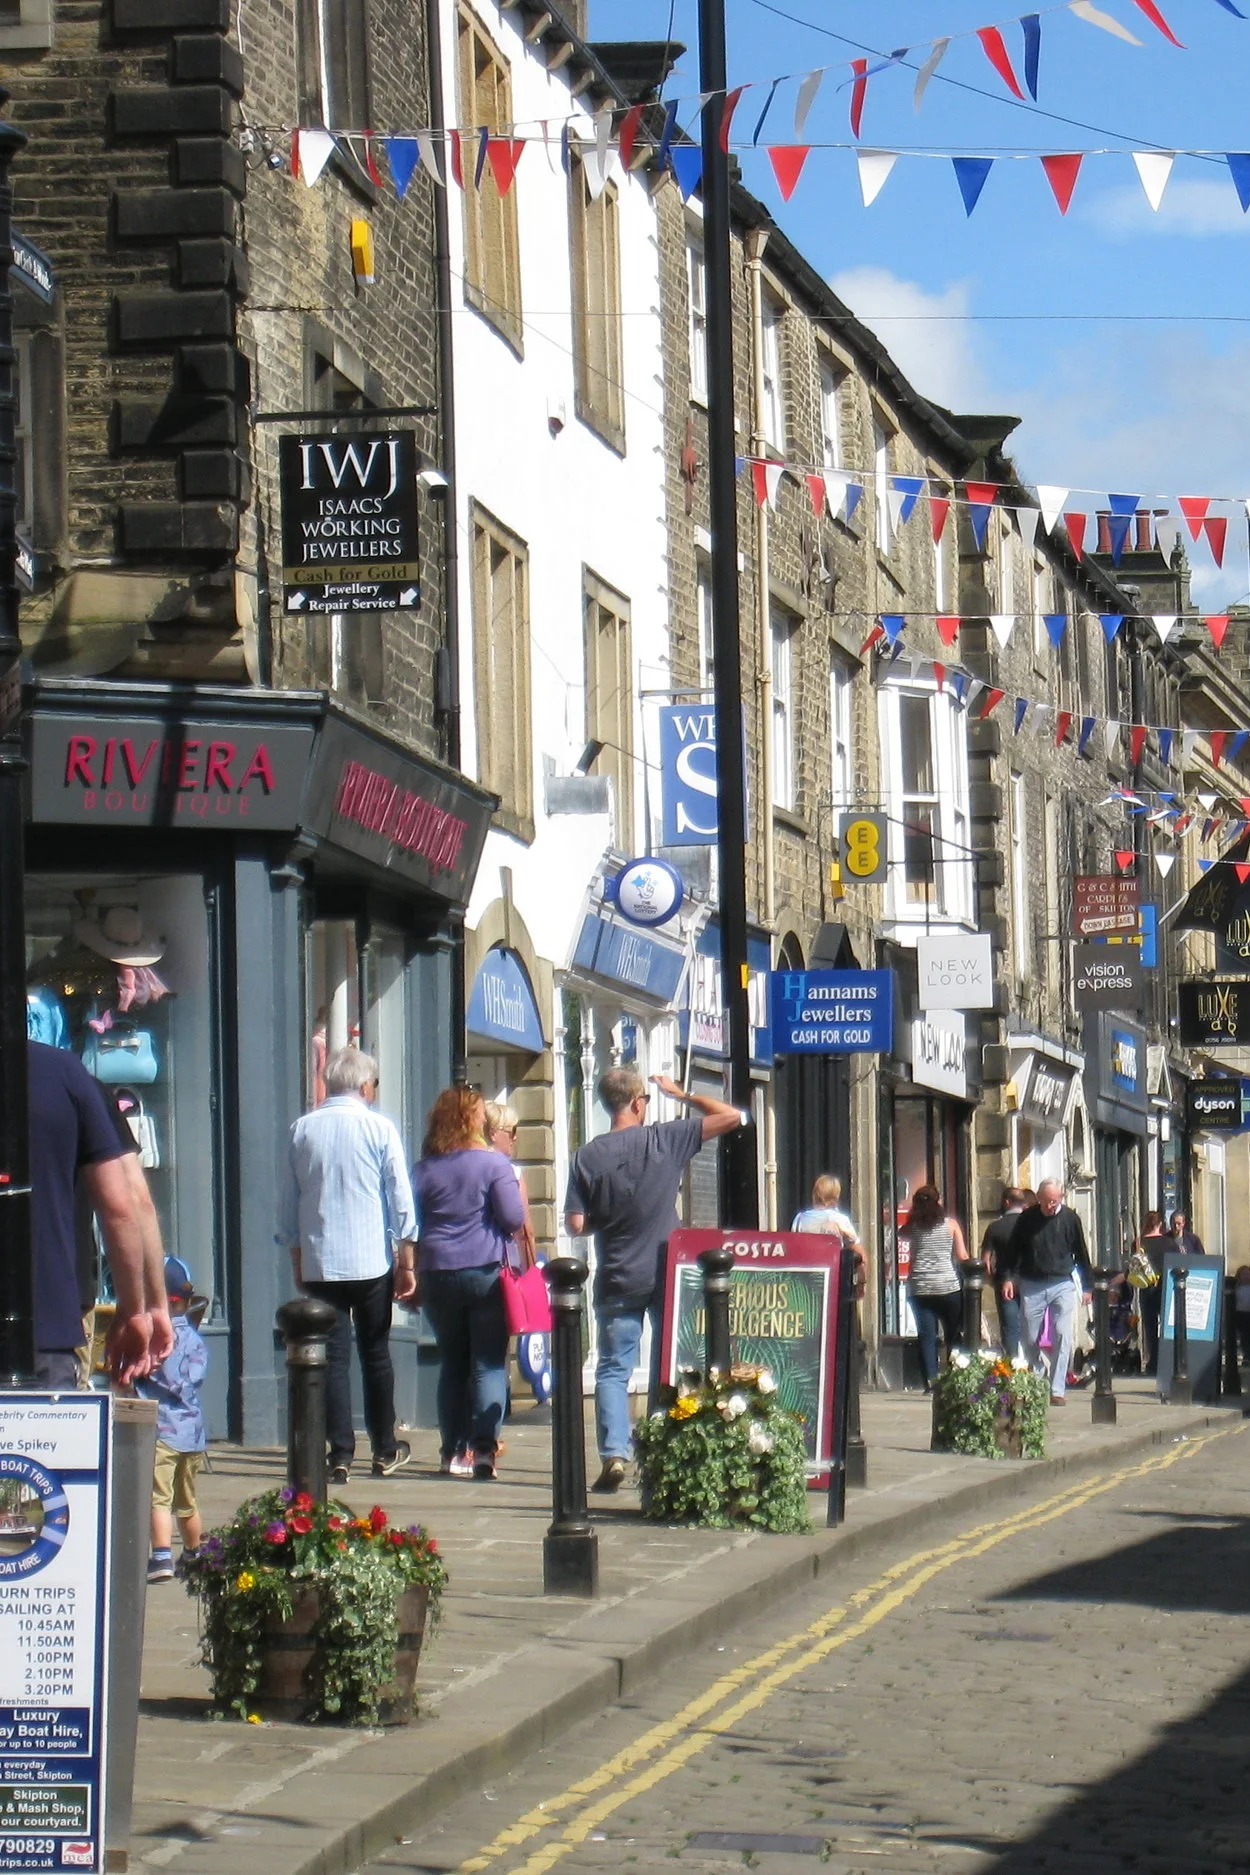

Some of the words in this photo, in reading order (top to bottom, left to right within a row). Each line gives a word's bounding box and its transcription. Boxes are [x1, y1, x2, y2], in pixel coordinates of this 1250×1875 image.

[299, 441, 399, 500] IWJ
[319, 497, 383, 517] ISAACS
[301, 518, 401, 538] WORKING
[302, 539, 402, 563] JEWELLERS
[294, 567, 334, 583] Cash
[339, 566, 362, 582] for
[367, 565, 407, 581] Gold
[322, 582, 380, 598] Jewellery
[308, 599, 350, 613] Repair
[352, 598, 396, 609] Service
[65, 735, 277, 793] RIVIERA
[931, 959, 979, 971] NEW
[1084, 962, 1125, 976] vision
[782, 974, 877, 1000] Hannams
[927, 974, 983, 987] LOOK
[1077, 977, 1132, 991] express
[482, 972, 526, 1033] WHSmith
[787, 1000, 872, 1023] Jewellers
[791, 1029, 818, 1045] CASH
[821, 1029, 841, 1044] FOR
[843, 1029, 871, 1044] GOLD
[1194, 1096, 1235, 1114] dyson
[722, 1242, 785, 1258] COSTA
[728, 1282, 789, 1309] ERIOUS
[695, 1308, 804, 1338] IULGENCE
[27, 1410, 87, 1421] Commentary
[17, 1439, 57, 1453] Spikey
[1, 1459, 29, 1474] BOAT
[29, 1467, 54, 1495] TRIPS
[18, 1552, 42, 1571] HIRE
[34, 1587, 76, 1599] TRIPS
[57, 1604, 76, 1615] AT
[18, 1619, 75, 1631] 10.45AM
[17, 1635, 75, 1647] 11.50AM
[26, 1652, 74, 1663] 1.00PM
[24, 1668, 74, 1679] 2.10PM
[24, 1684, 74, 1695] 3.20PM
[13, 1709, 60, 1724] Luxury
[18, 1725, 51, 1737] Boat
[52, 1725, 83, 1739] Hire,
[9, 1740, 21, 1749] up
[23, 1739, 33, 1748] to
[35, 1739, 45, 1748] 10
[47, 1739, 77, 1750] people
[4, 1760, 46, 1771] everyday
[4, 1771, 35, 1781] Street,
[37, 1771, 73, 1781] Skipton
[13, 1790, 58, 1801] Skipton
[6, 1804, 15, 1813] &
[18, 1803, 49, 1814] Mash
[51, 1803, 85, 1815] Shop,
[1, 1817, 22, 1827] our
[24, 1816, 82, 1829] courtyard.
